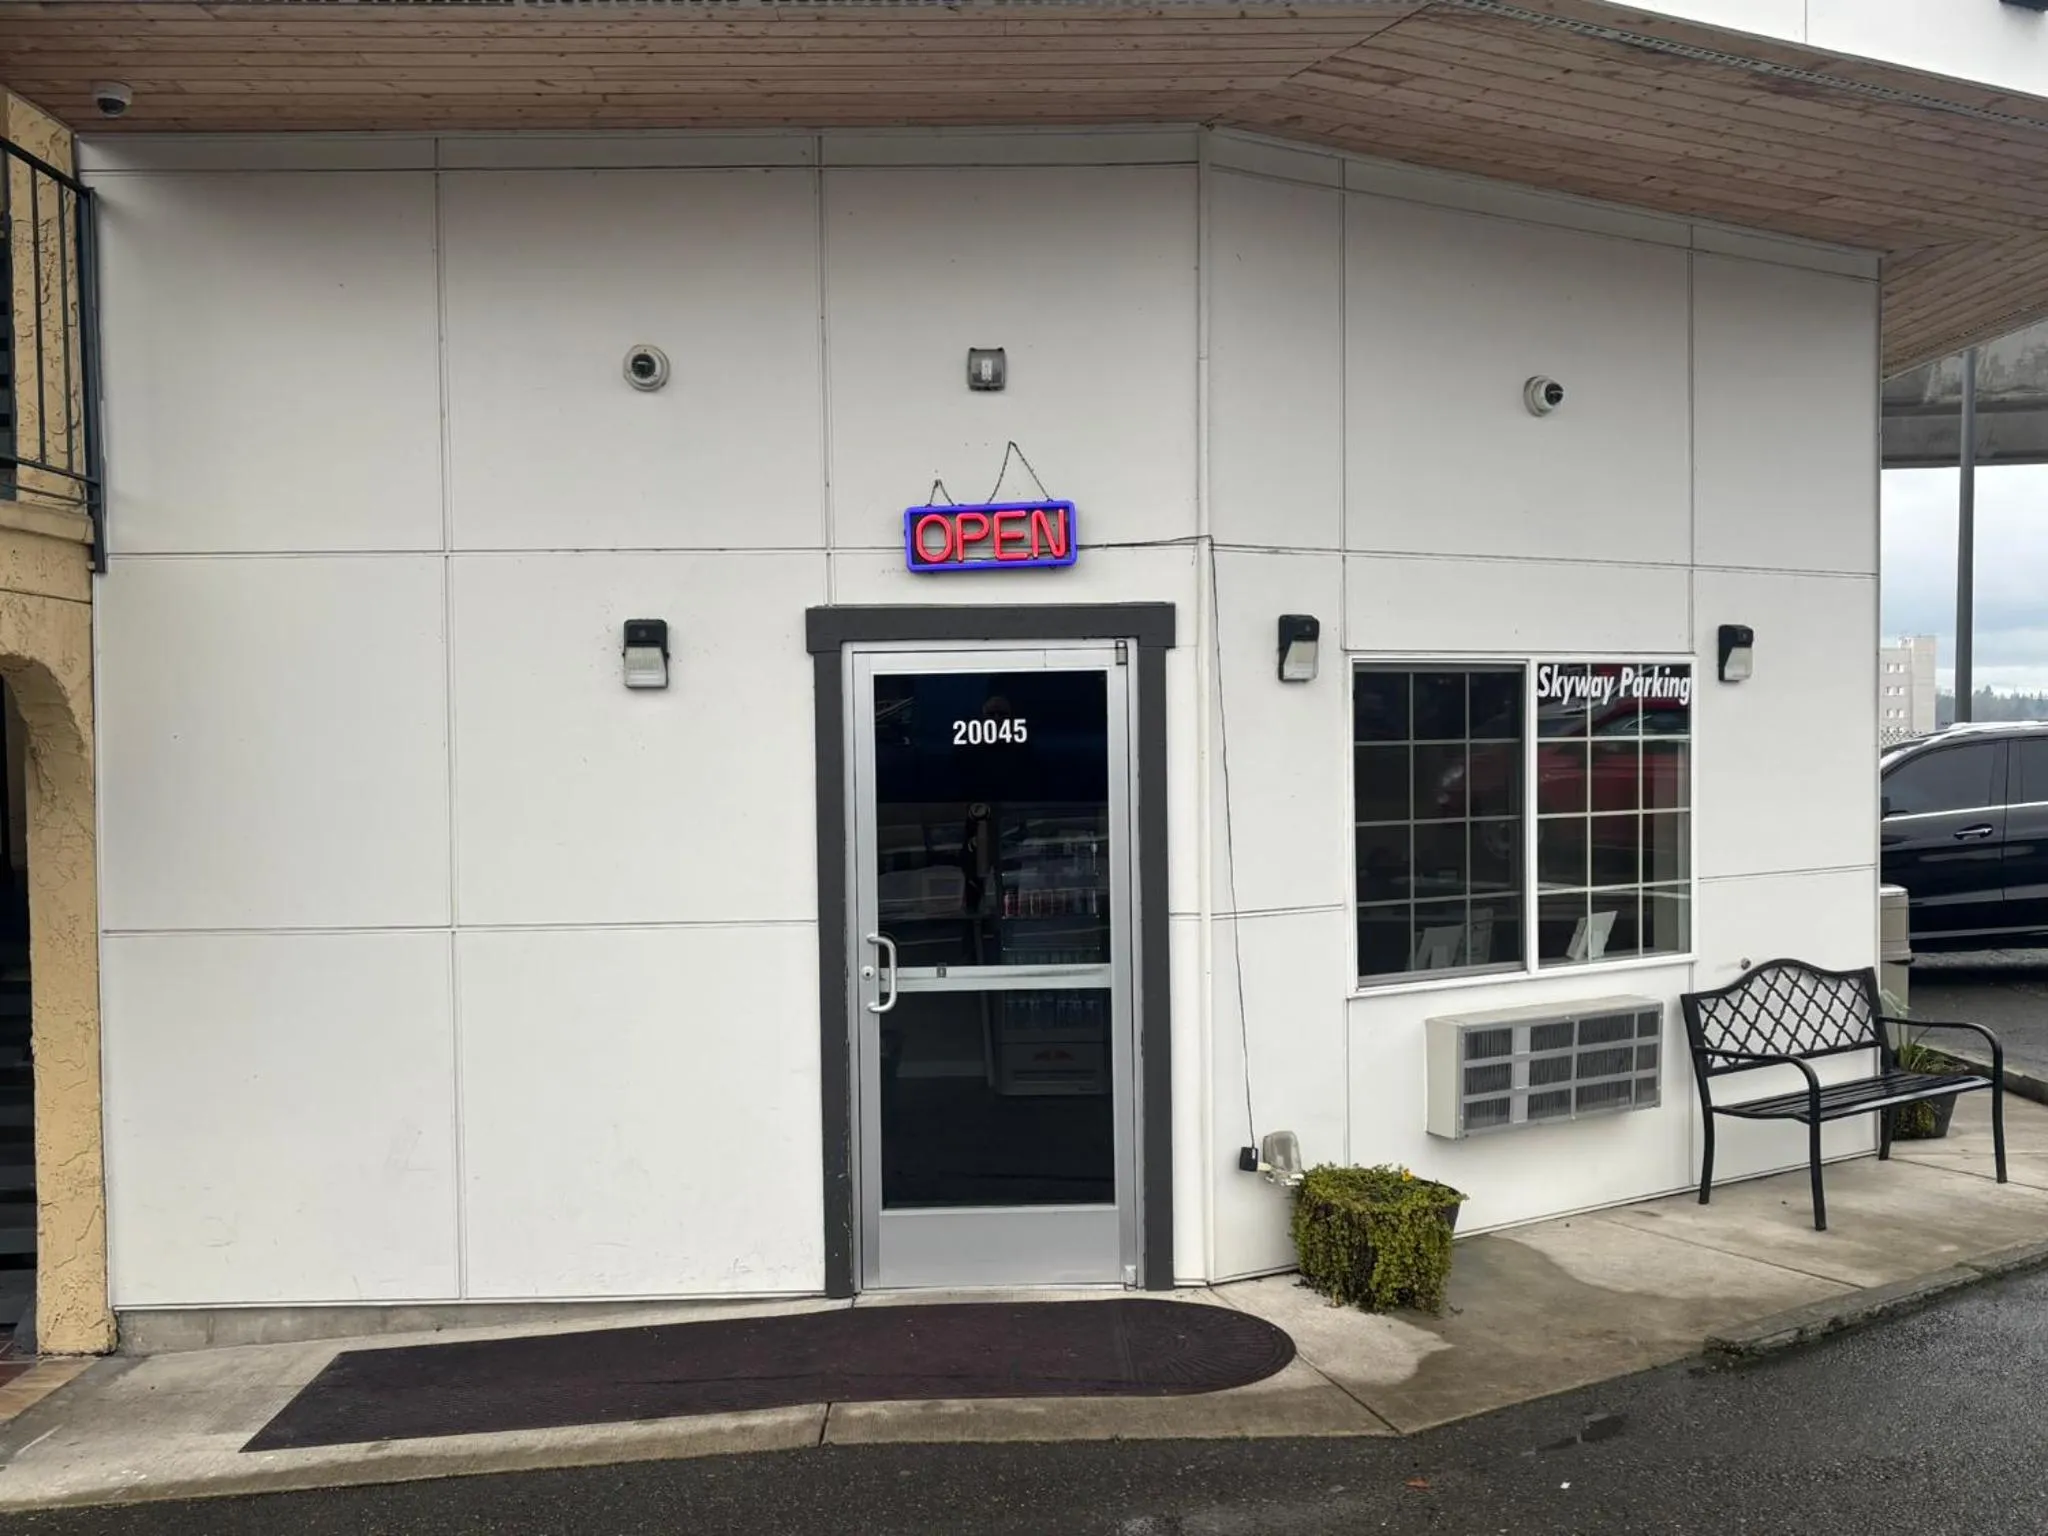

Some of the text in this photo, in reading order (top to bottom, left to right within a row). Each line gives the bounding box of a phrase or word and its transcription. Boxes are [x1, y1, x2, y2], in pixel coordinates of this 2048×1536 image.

[916, 509, 1067, 563] OPEN
[1538, 664, 1692, 706] Skyway Parking
[952, 718, 1028, 746] 20045
